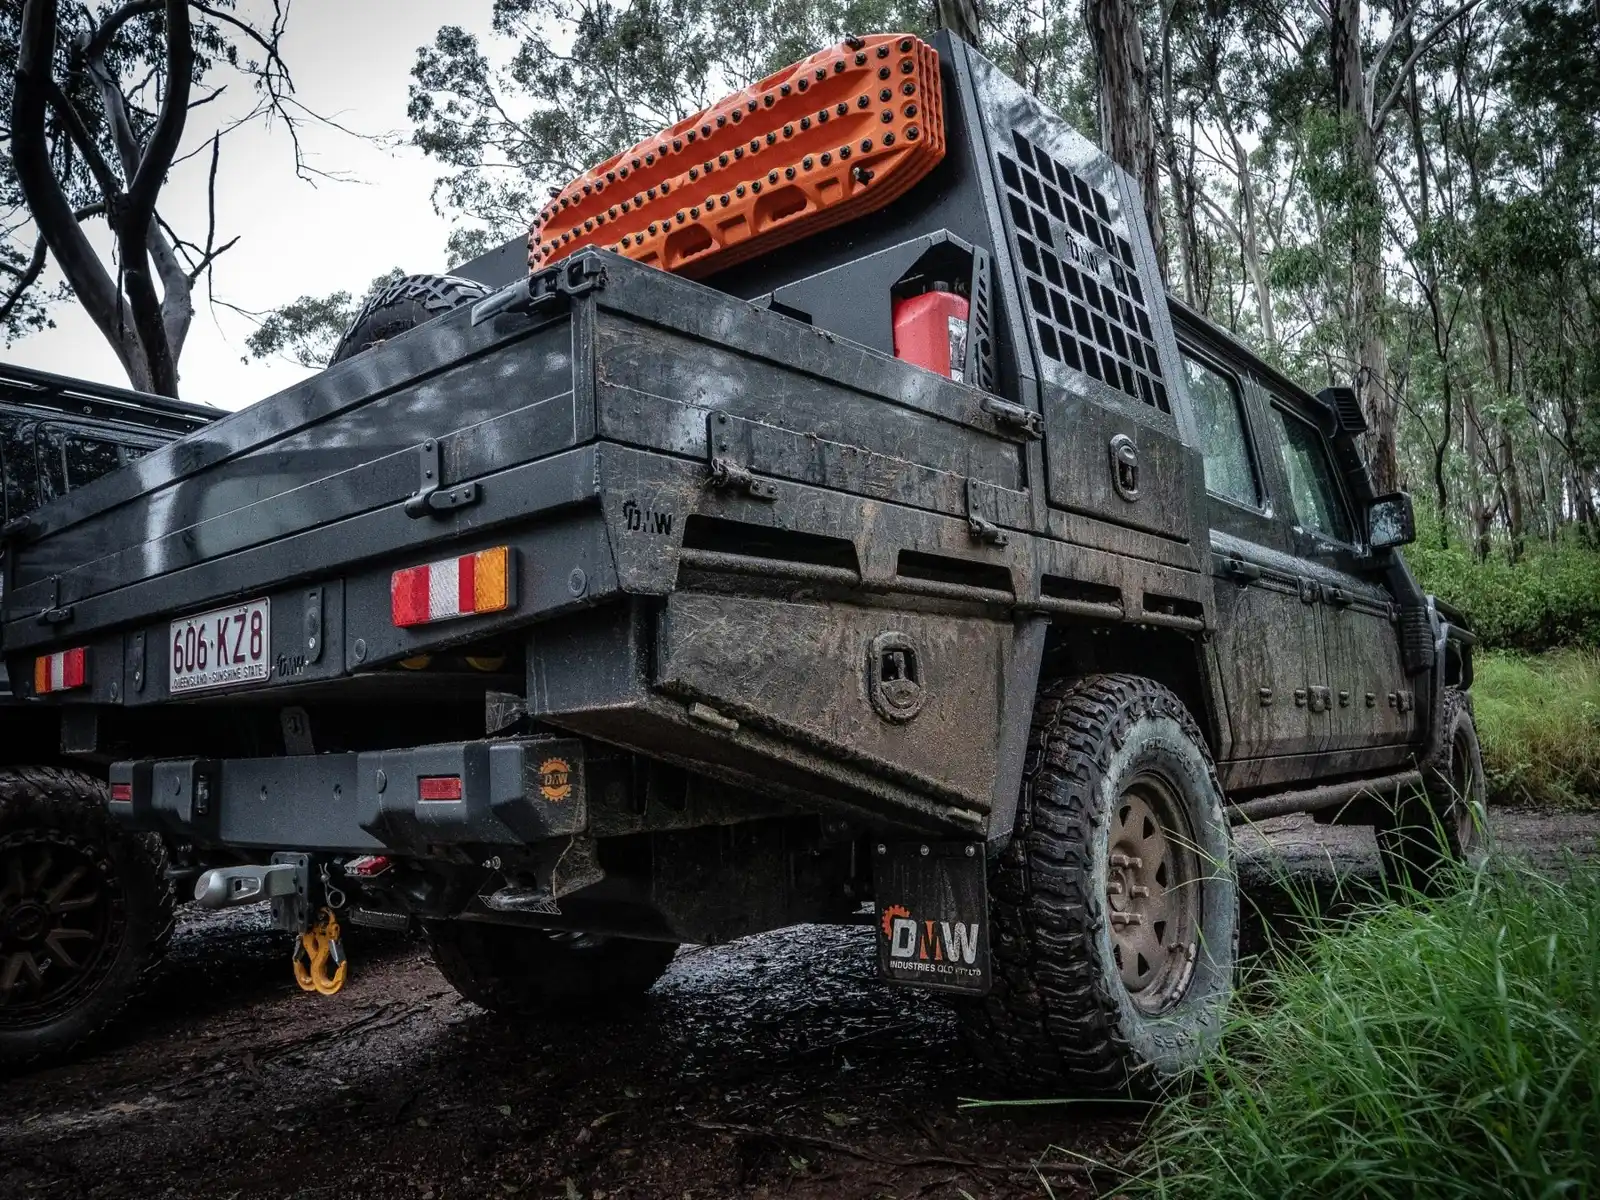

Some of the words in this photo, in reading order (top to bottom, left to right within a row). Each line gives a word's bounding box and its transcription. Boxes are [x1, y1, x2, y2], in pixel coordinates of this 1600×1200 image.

[212, 666, 241, 683] SUNSHINE
[243, 663, 263, 679] STATE
[891, 918, 980, 964] DMW
[890, 961, 936, 973] INDUSTRIES
[937, 964, 954, 974] QLD
